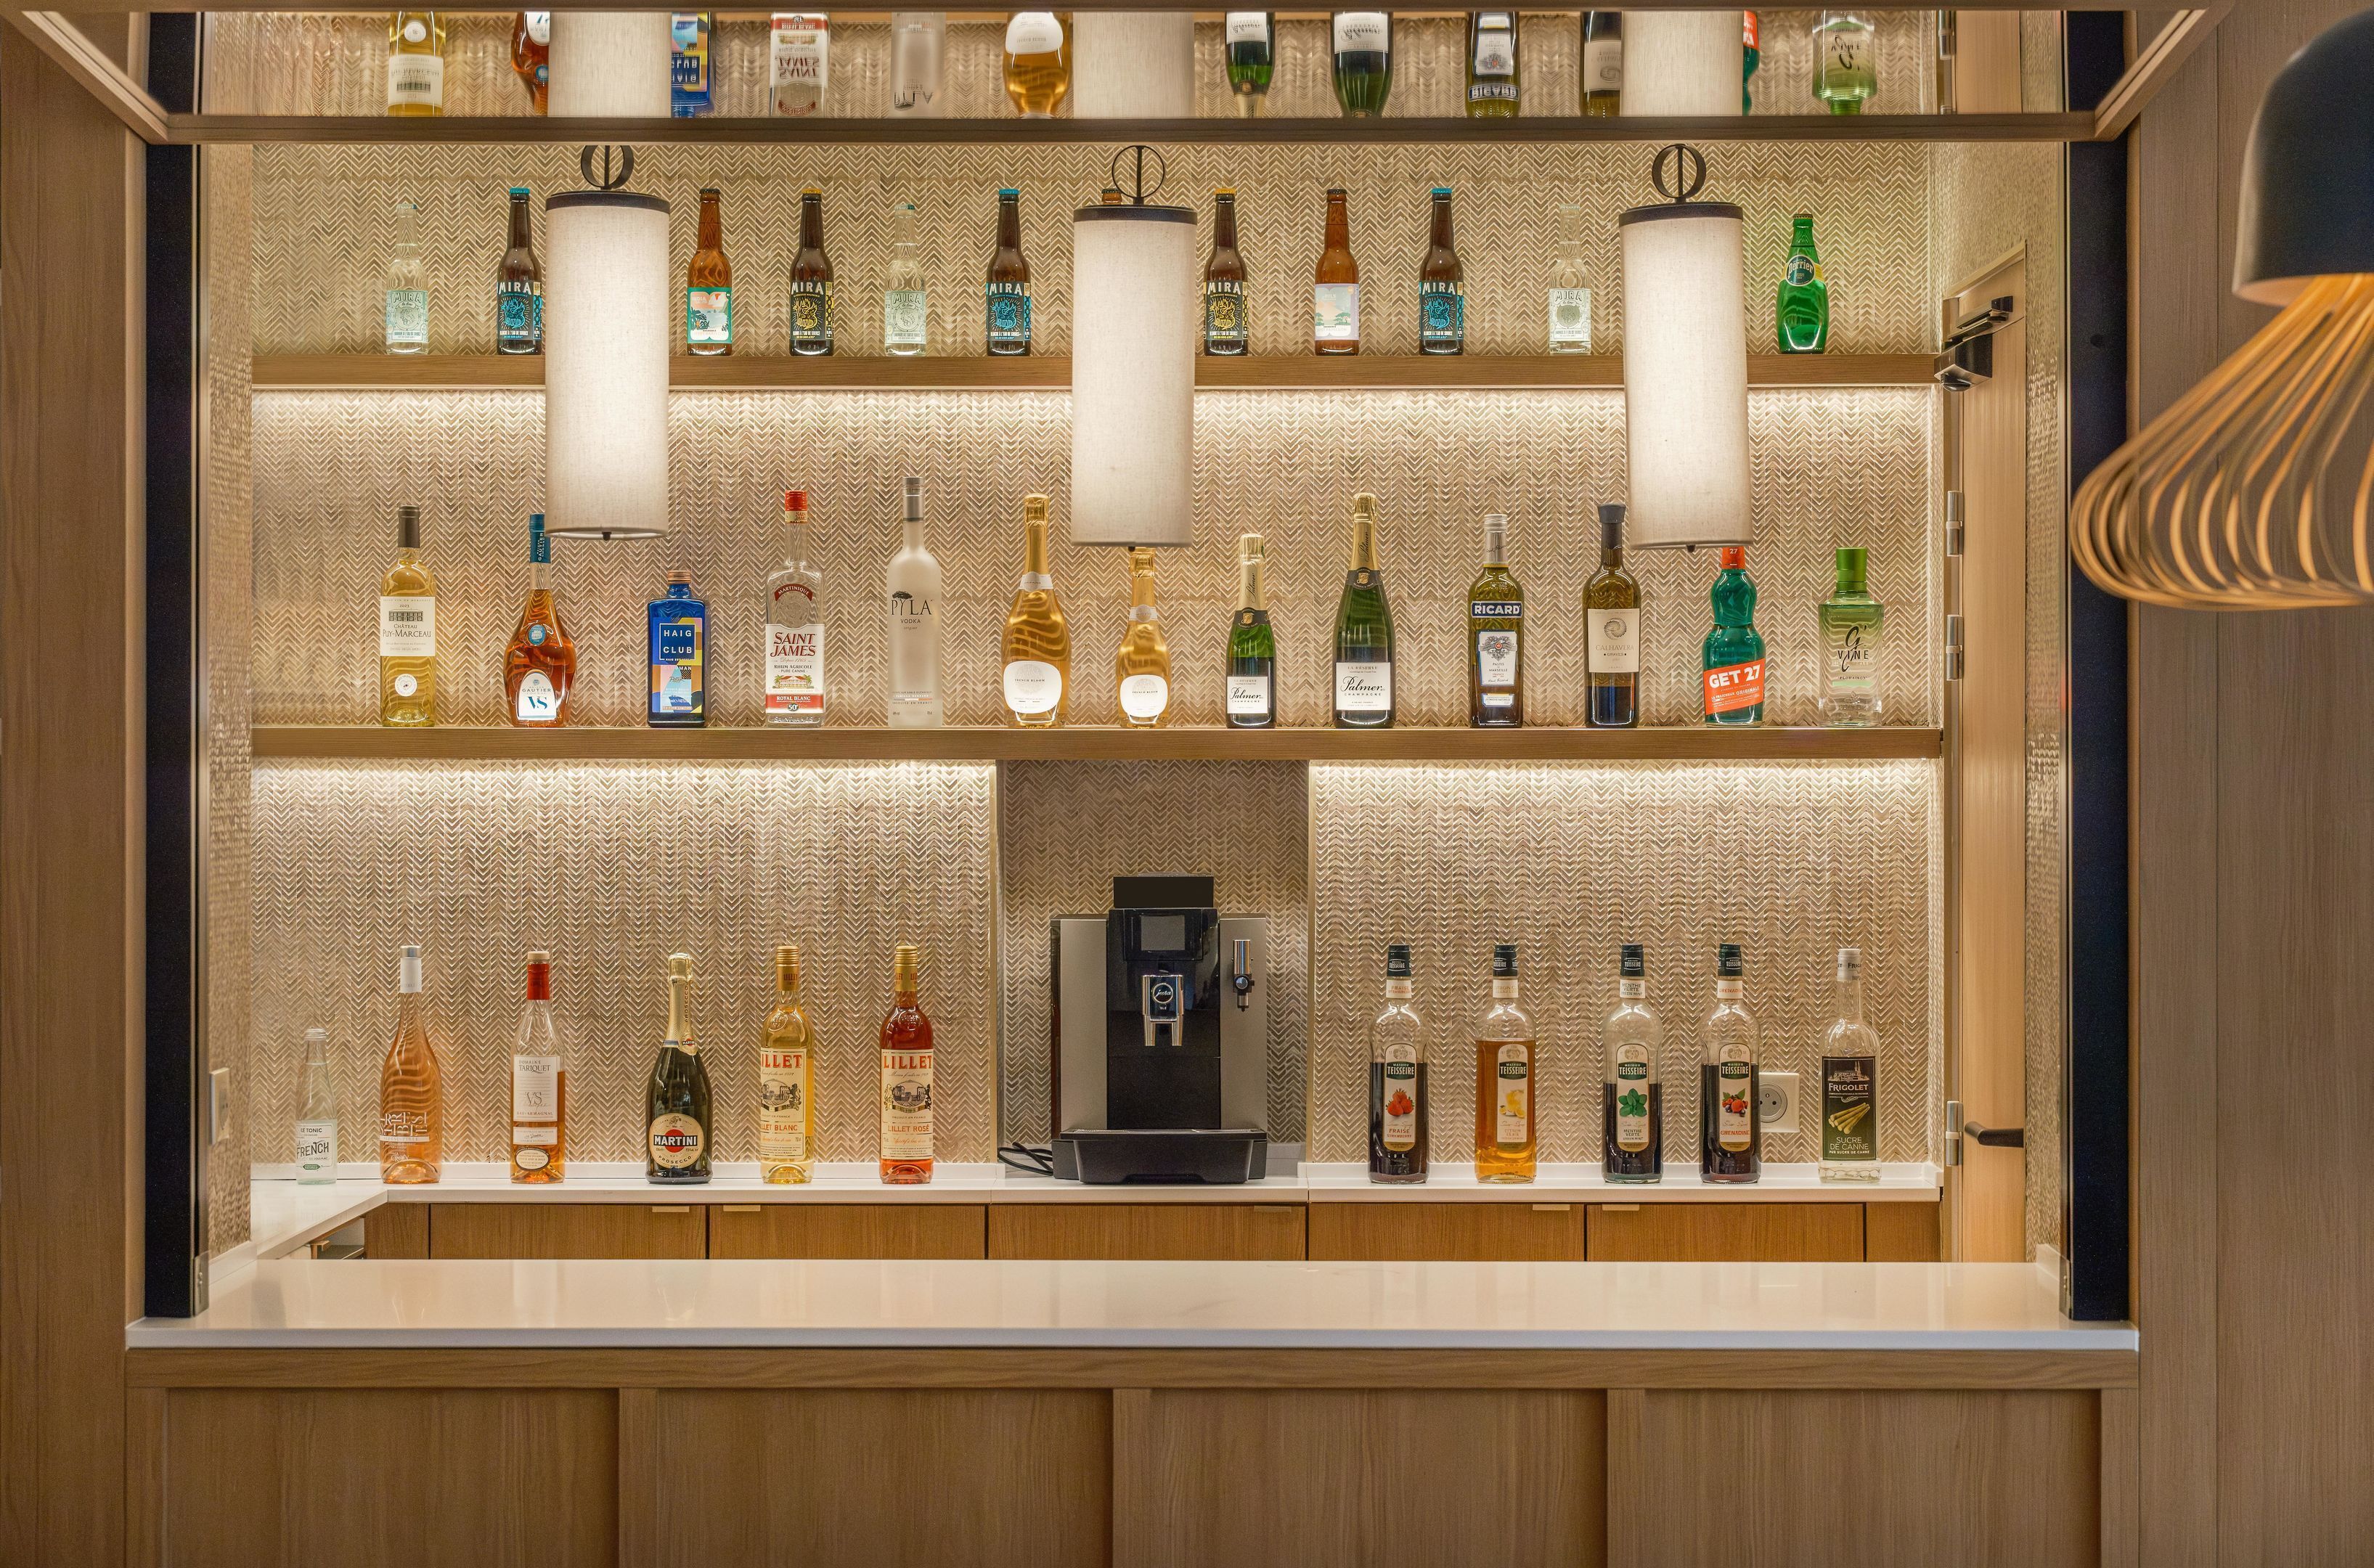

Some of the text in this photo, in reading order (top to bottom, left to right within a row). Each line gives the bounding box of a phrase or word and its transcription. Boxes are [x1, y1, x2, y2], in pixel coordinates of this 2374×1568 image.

[498, 282, 531, 295] MIRA
[791, 282, 823, 295] MIRA
[989, 283, 1022, 296] MIRA
[1207, 282, 1241, 295] MIRA
[1422, 282, 1456, 295] MIRA
[393, 293, 421, 303] MIRA
[893, 293, 921, 304] MIRA
[1555, 291, 1582, 301] MIRA
[1358, 531, 1368, 563] Palmer
[778, 586, 809, 595] MARTINIQUE
[1245, 573, 1255, 603] Palmer
[892, 600, 931, 616] PYLA
[1474, 605, 1520, 614] RICARD
[383, 629, 431, 637] PUY-MARCEAU
[774, 632, 815, 645] SAINT
[770, 645, 816, 658] JAMES
[1837, 650, 1869, 659] VINE
[1709, 664, 1760, 688] GET 27
[1341, 676, 1382, 692] Palmer
[1736, 686, 1759, 695] ORIGINALE
[1230, 687, 1261, 700] Palmer
[529, 696, 547, 709] VS
[884, 1055, 931, 1069] LILLET
[518, 1065, 550, 1074] TARIQUET
[1387, 1066, 1414, 1076] TEISSEIRE
[1500, 1066, 1527, 1075] TEISSEIRE
[1619, 1066, 1646, 1075] TEISSEIRE
[1721, 1066, 1748, 1074] TEISSEIRE
[1829, 1083, 1868, 1092] FRIGOLET
[525, 1092, 542, 1105] VS
[654, 1136, 697, 1146] MARTINI
[297, 1142, 329, 1159] FRENCH
